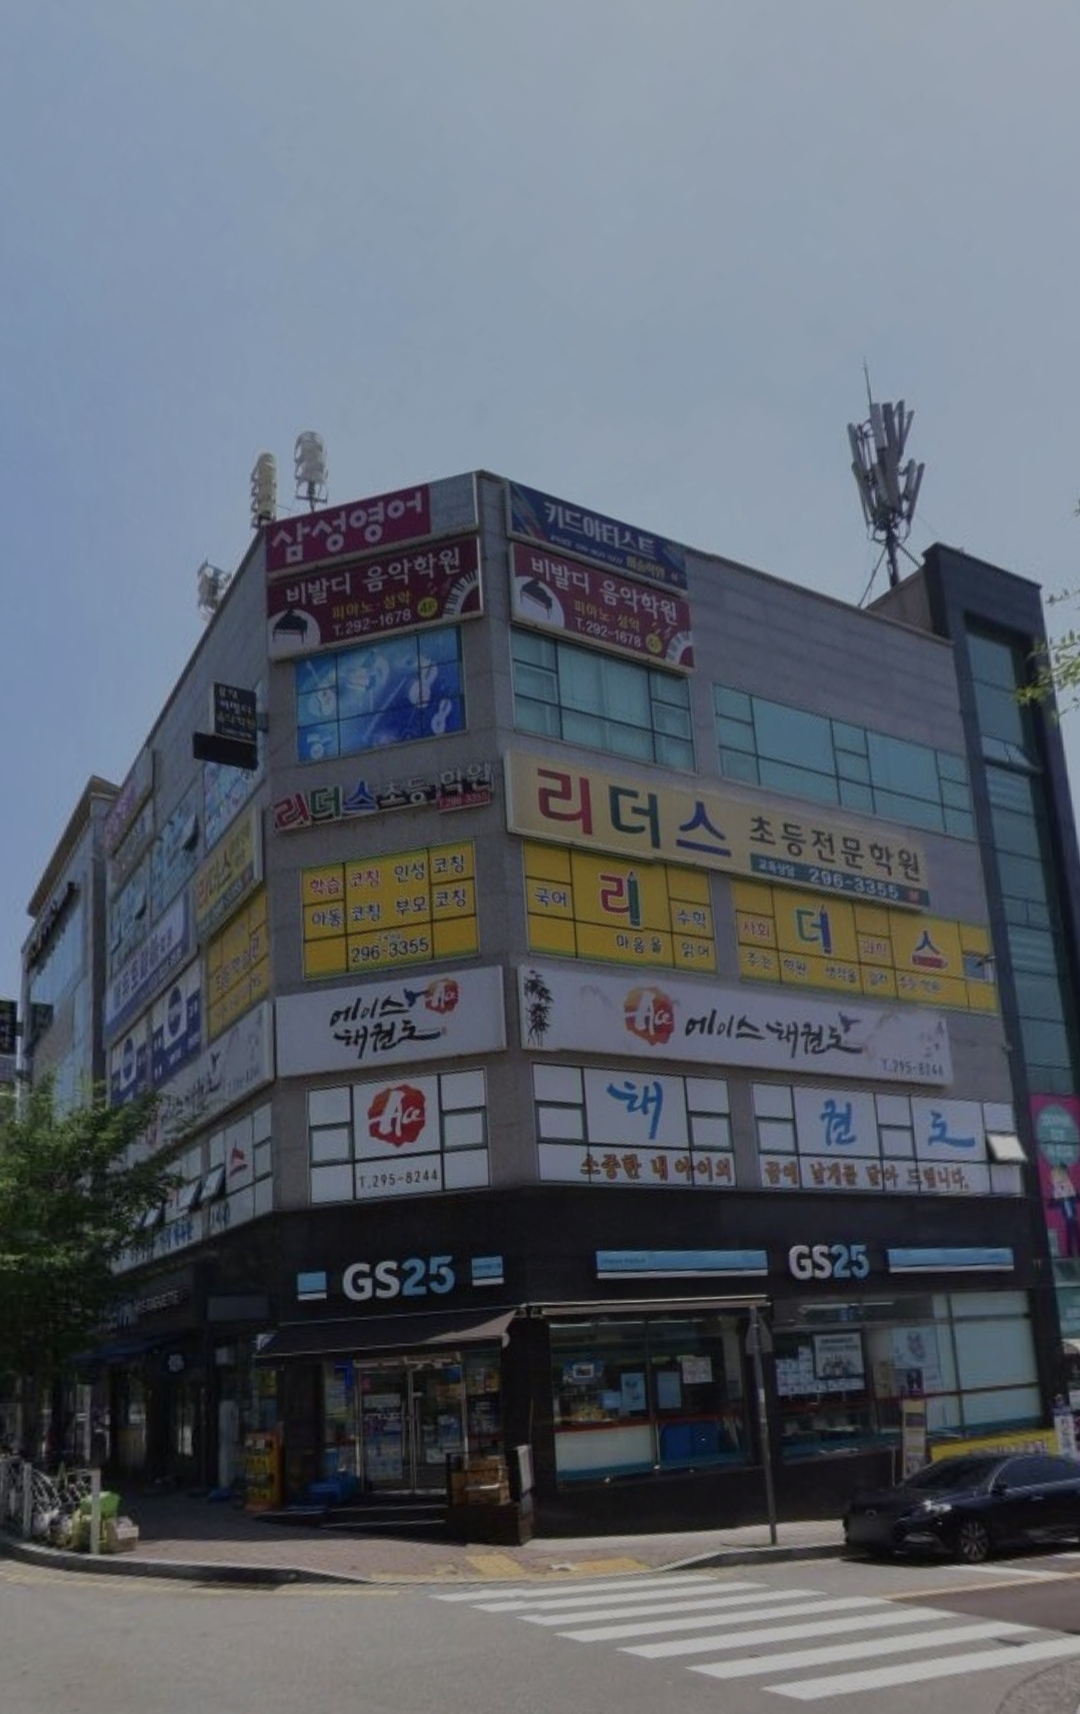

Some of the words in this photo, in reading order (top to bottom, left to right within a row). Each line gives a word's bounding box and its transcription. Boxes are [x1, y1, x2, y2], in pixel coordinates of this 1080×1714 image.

[272, 491, 422, 563] 삼성영어
[543, 501, 657, 561] 키드아티스트
[286, 572, 351, 606] 비발디
[362, 547, 460, 593] 음악학원
[530, 557, 590, 595] 비발디
[599, 579, 678, 626] 음악학원
[332, 601, 373, 619] 피아노
[333, 609, 412, 637] T.292-1678
[573, 600, 611, 623] 피아노
[274, 779, 379, 832] 리더스
[538, 768, 732, 857] 리더스
[750, 816, 921, 883] 초등전문학원
[310, 877, 340, 895] 학습
[352, 869, 380, 887] 코칭
[394, 861, 425, 883] 인성
[434, 854, 465, 874] 코칭
[808, 867, 900, 901] 296-3355
[312, 909, 342, 928] 아동
[352, 903, 381, 922] 코칭
[396, 897, 428, 917] 부모
[435, 888, 467, 908] 코칭
[535, 887, 567, 907] 국어
[330, 995, 409, 1027] 에이스
[685, 1008, 765, 1040] 에이스
[359, 1170, 438, 1190] T.295-8244
[580, 1153, 642, 1180] 소중한
[342, 1255, 456, 1301] GS25
[789, 1244, 870, 1280] GS25
